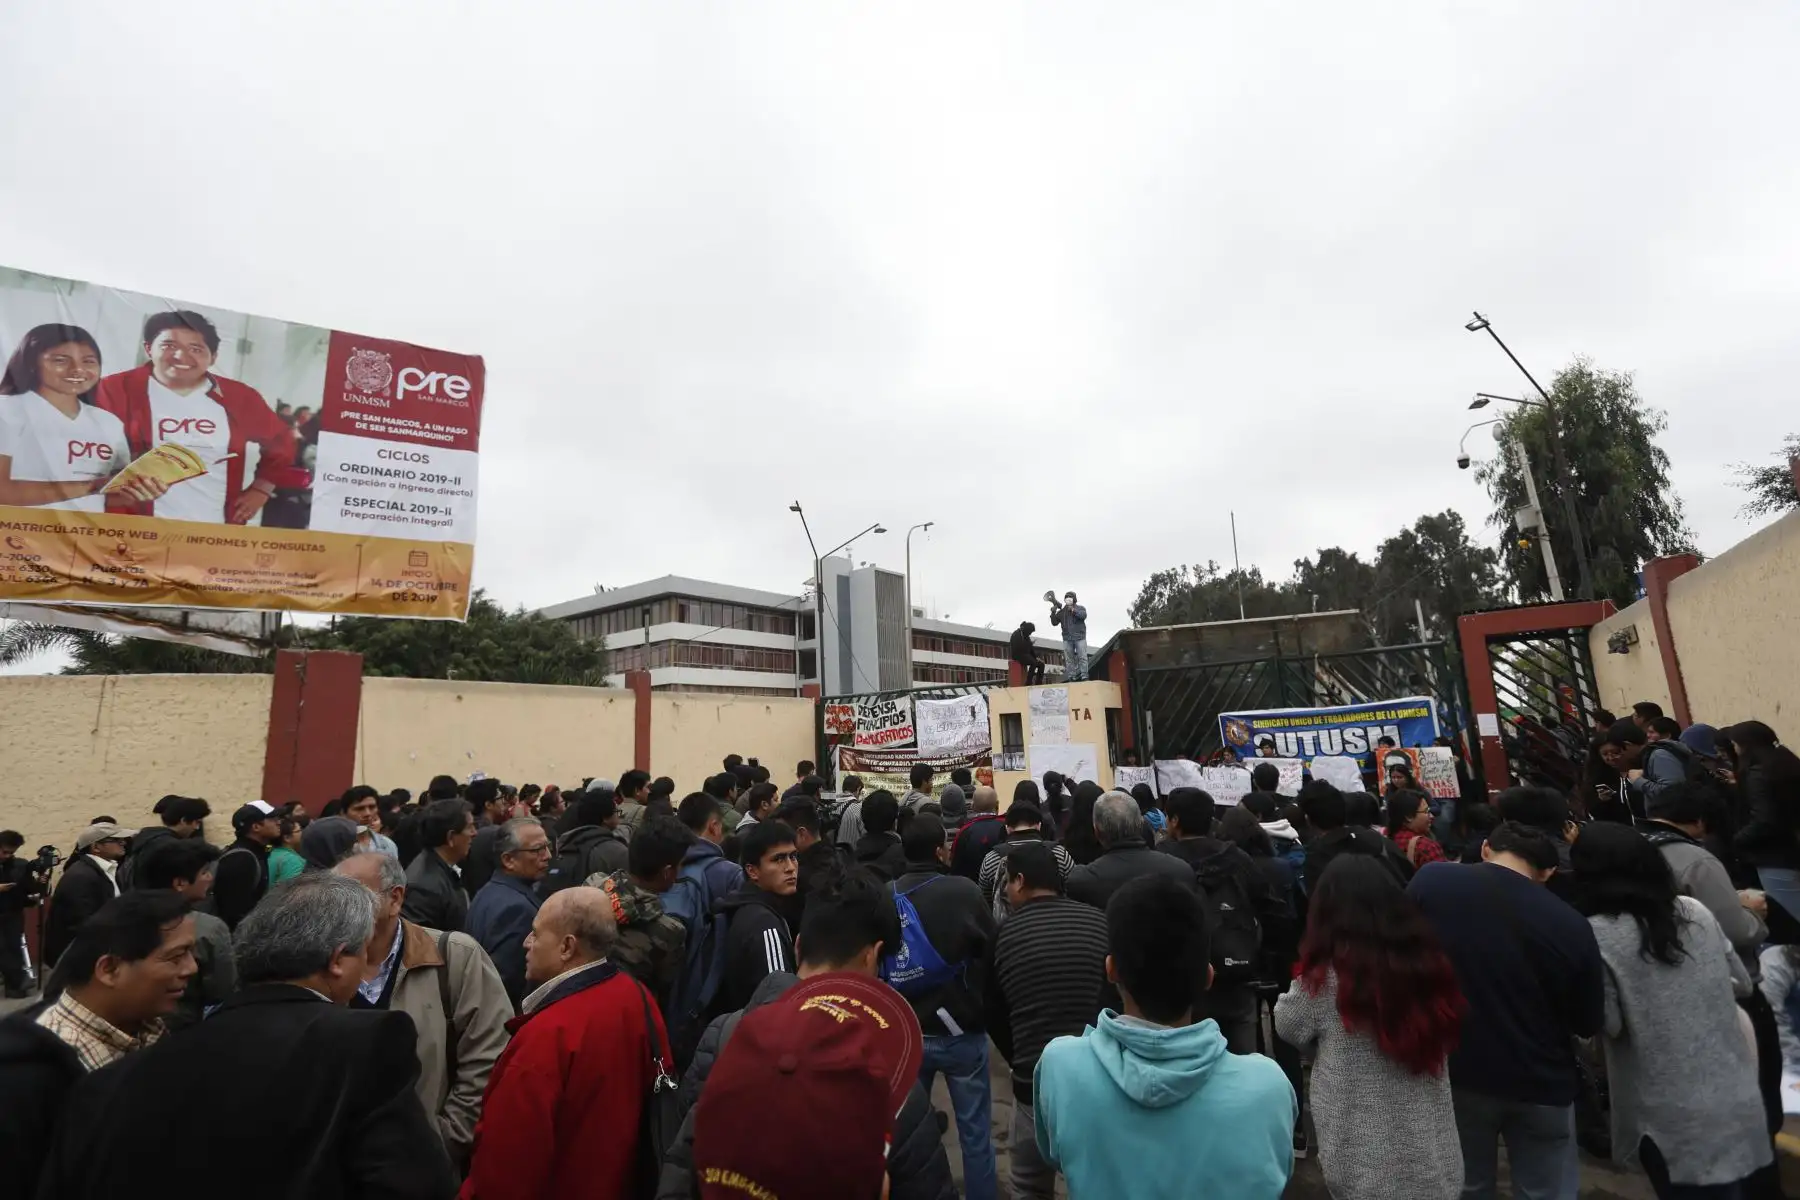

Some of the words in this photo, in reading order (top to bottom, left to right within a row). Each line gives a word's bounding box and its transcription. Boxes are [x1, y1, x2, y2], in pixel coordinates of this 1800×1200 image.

[396, 367, 471, 400] pre
[342, 392, 391, 408] UNMSM
[417, 394, 434, 402] SAN
[435, 397, 469, 408] MARCOS
[158, 417, 216, 441] pre
[340, 410, 361, 421] ¡PRE
[362, 412, 381, 422] SAN
[383, 415, 422, 429] MARCOS,
[431, 423, 445, 432] UN
[445, 425, 468, 435] PASO
[355, 421, 368, 431] DE
[369, 423, 386, 433] SER
[387, 426, 454, 442] SANMARQUINO!
[68, 440, 113, 464] pre
[377, 449, 431, 465] CICLOS
[339, 462, 416, 480] ORDINARIO
[419, 472, 462, 486] 2019-II
[322, 473, 349, 484] (Con
[351, 476, 387, 490] opción
[436, 487, 474, 498] directo)
[344, 496, 406, 512] ESPECIAL
[409, 503, 452, 516] 2019-II
[340, 509, 409, 524] (Preparación
[0, 520, 95, 536] MATRICÚLATE
[98, 528, 125, 539] POR
[128, 529, 158, 541] WEB
[186, 535, 247, 548] INFORMES
[251, 540, 259, 549] Y
[261, 541, 326, 553] CONSULTAS
[91, 563, 146, 574] Puertas
[401, 570, 433, 578] INICIO
[371, 578, 382, 587] 14
[386, 579, 401, 588] DE
[405, 581, 458, 592] OCTUBRE
[392, 592, 409, 602] DE
[411, 592, 439, 603] 2019
[858, 701, 897, 718] DEFENSA
[1252, 718, 1289, 729] SINDICATO
[1313, 715, 1323, 725] DE
[1376, 710, 1387, 720] DE
[1388, 709, 1397, 719] LA
[1253, 724, 1402, 758] SUTUSM
